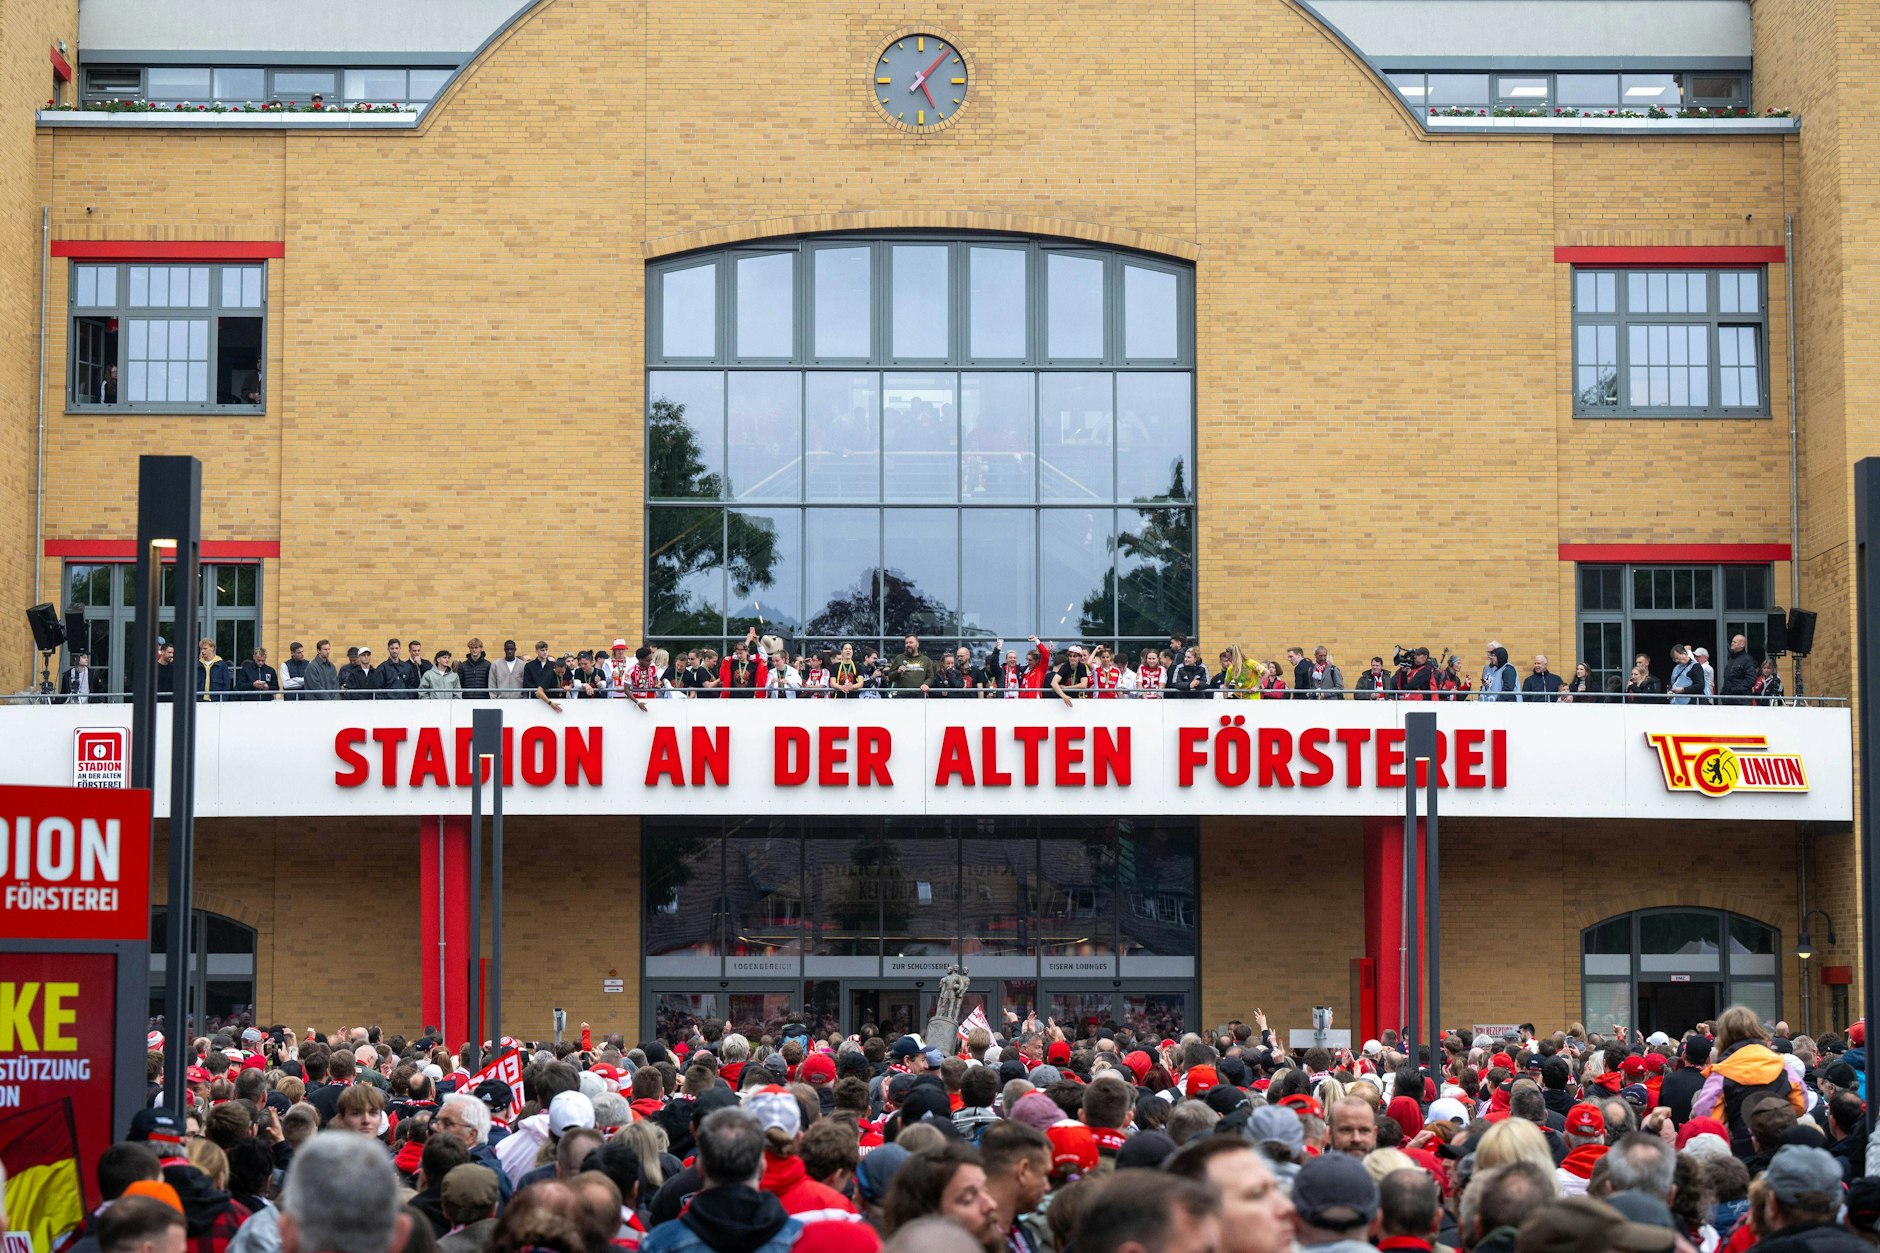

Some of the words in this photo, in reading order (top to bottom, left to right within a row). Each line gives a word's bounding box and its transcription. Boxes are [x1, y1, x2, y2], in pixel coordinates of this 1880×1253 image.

[78, 762, 121, 771] STADION
[334, 726, 603, 788] STADION
[645, 726, 730, 787] AN
[774, 726, 894, 787] DER
[935, 726, 1131, 787] ALTEN
[1740, 757, 1805, 786] UNION
[77, 779, 122, 788] FÖRSTEREI
[0, 816, 120, 882] ION
[5, 881, 119, 912] FÖRSTEREI
[0, 982, 79, 1052] KE
